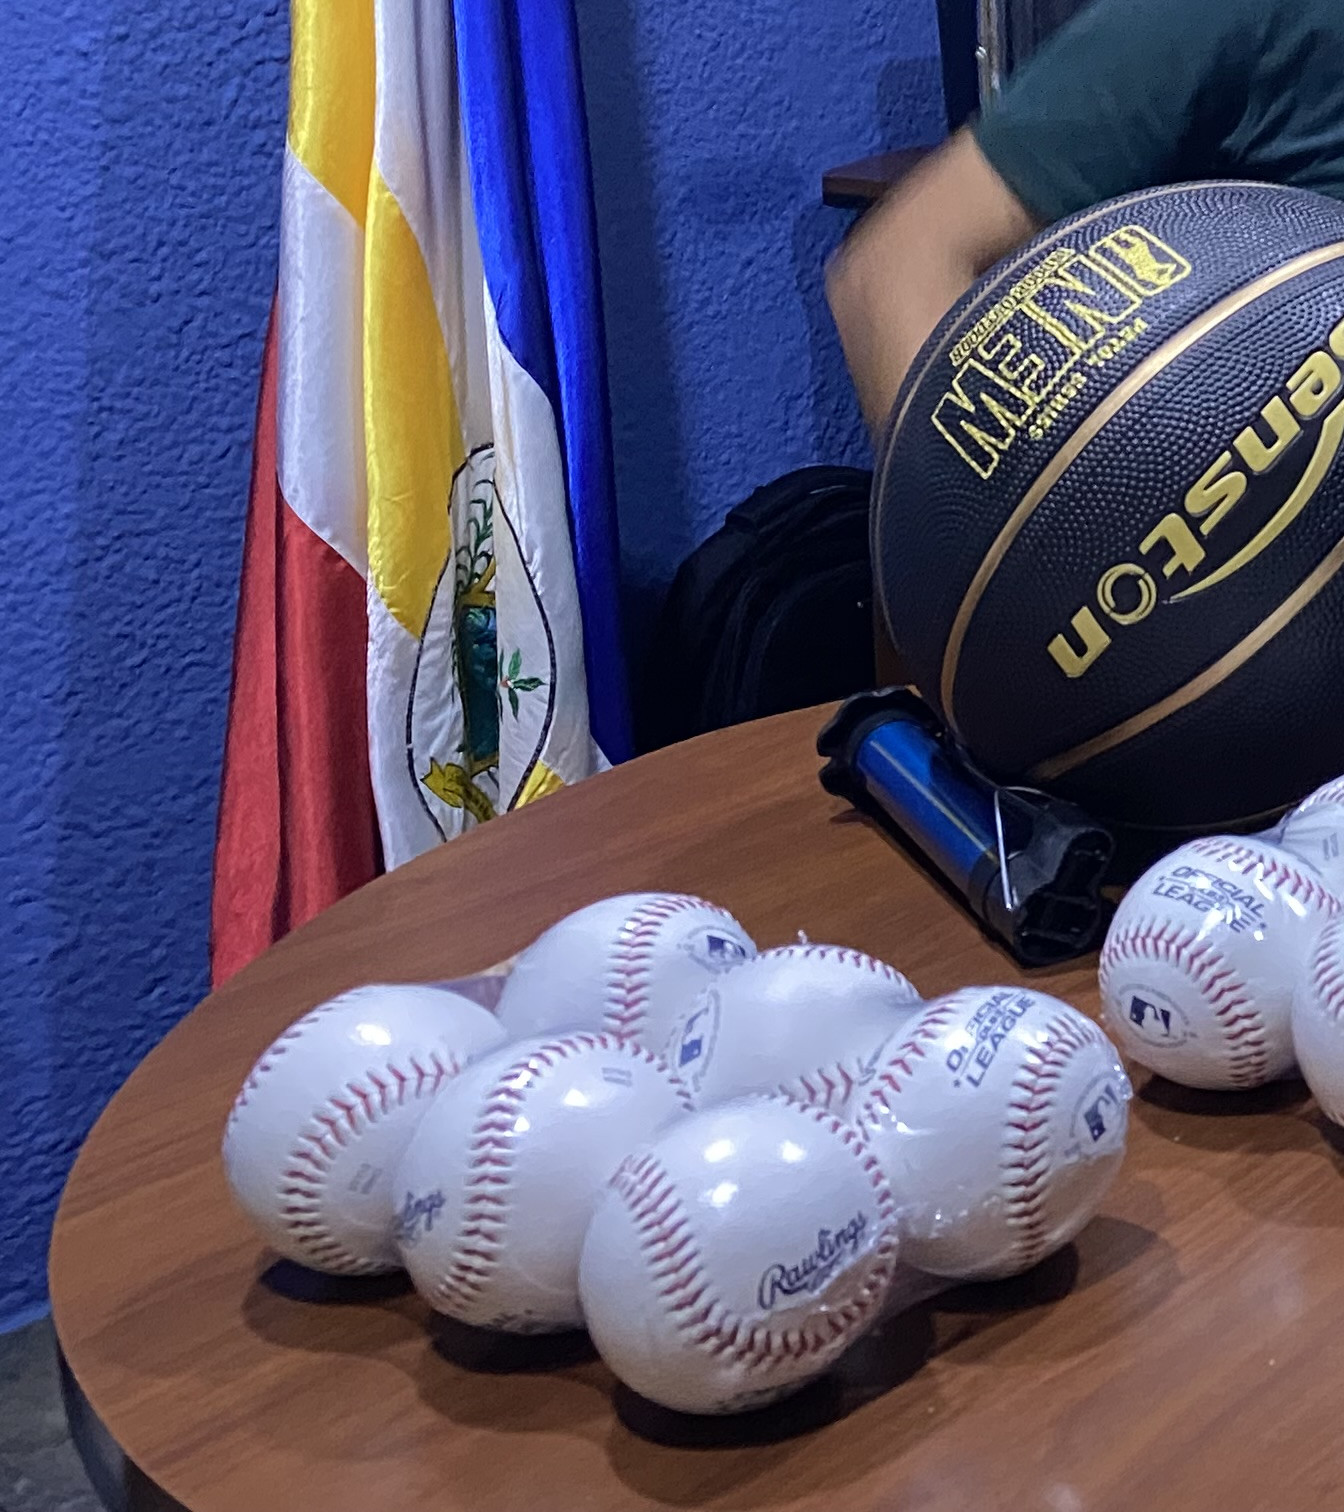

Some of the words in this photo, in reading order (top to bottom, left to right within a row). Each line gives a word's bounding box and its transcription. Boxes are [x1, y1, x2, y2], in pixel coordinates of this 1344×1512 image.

[930, 253, 1143, 480] NEW
[1152, 882, 1247, 933] LEAGE
[966, 996, 1036, 1088] LEAGUE
[757, 1209, 868, 1310] Rawlings
